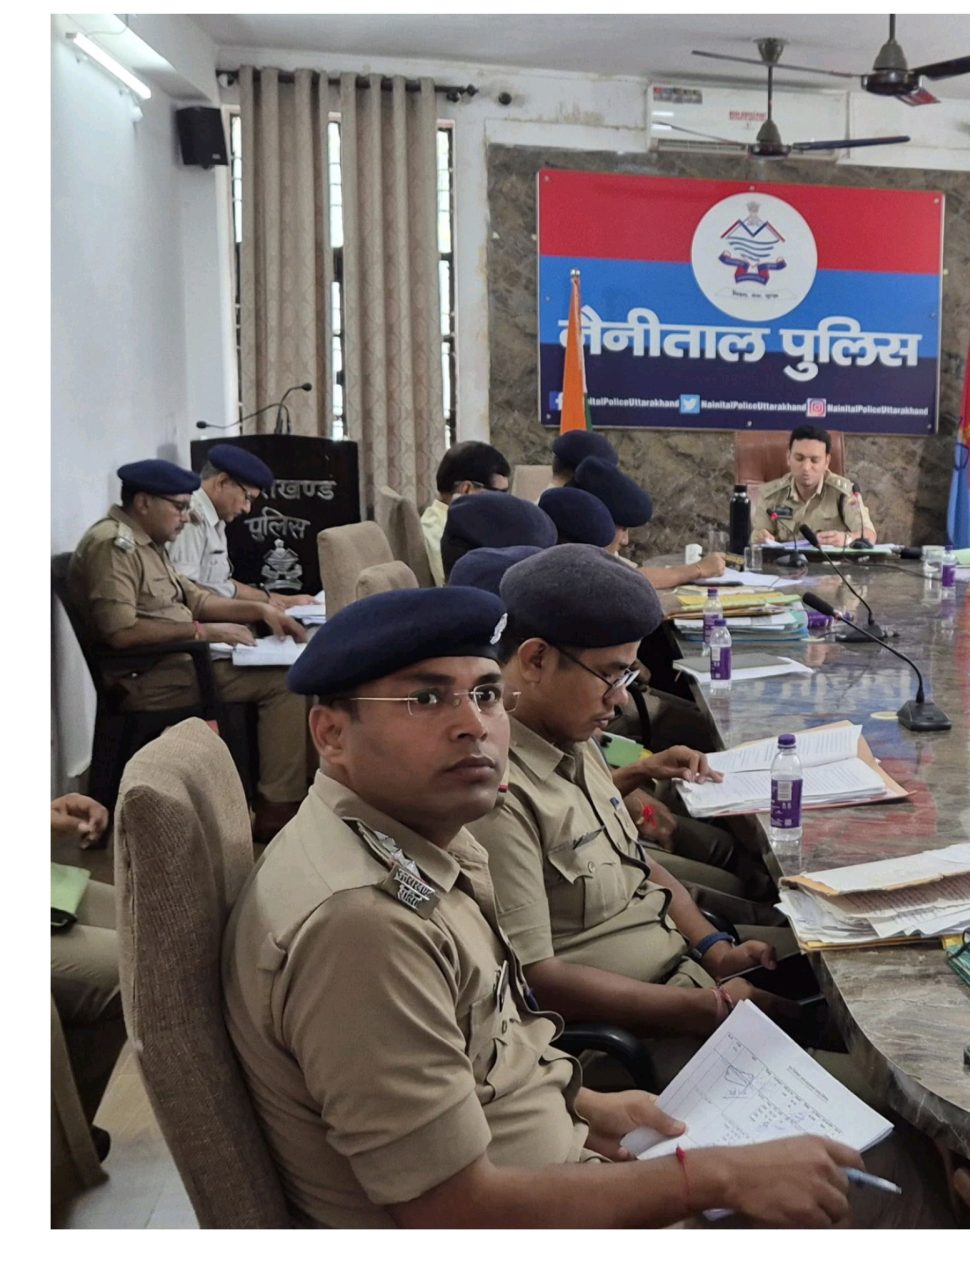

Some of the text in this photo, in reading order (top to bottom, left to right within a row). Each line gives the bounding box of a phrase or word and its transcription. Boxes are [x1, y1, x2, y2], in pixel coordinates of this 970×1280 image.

[779, 316, 923, 382] पुलिस
[588, 397, 680, 408] italPoliceUttarakhand
[701, 400, 806, 412] NainitalPoliceUttarakhand
[827, 403, 929, 416] NainitalPoliceUttarakhand
[244, 506, 311, 542] पुलिस
